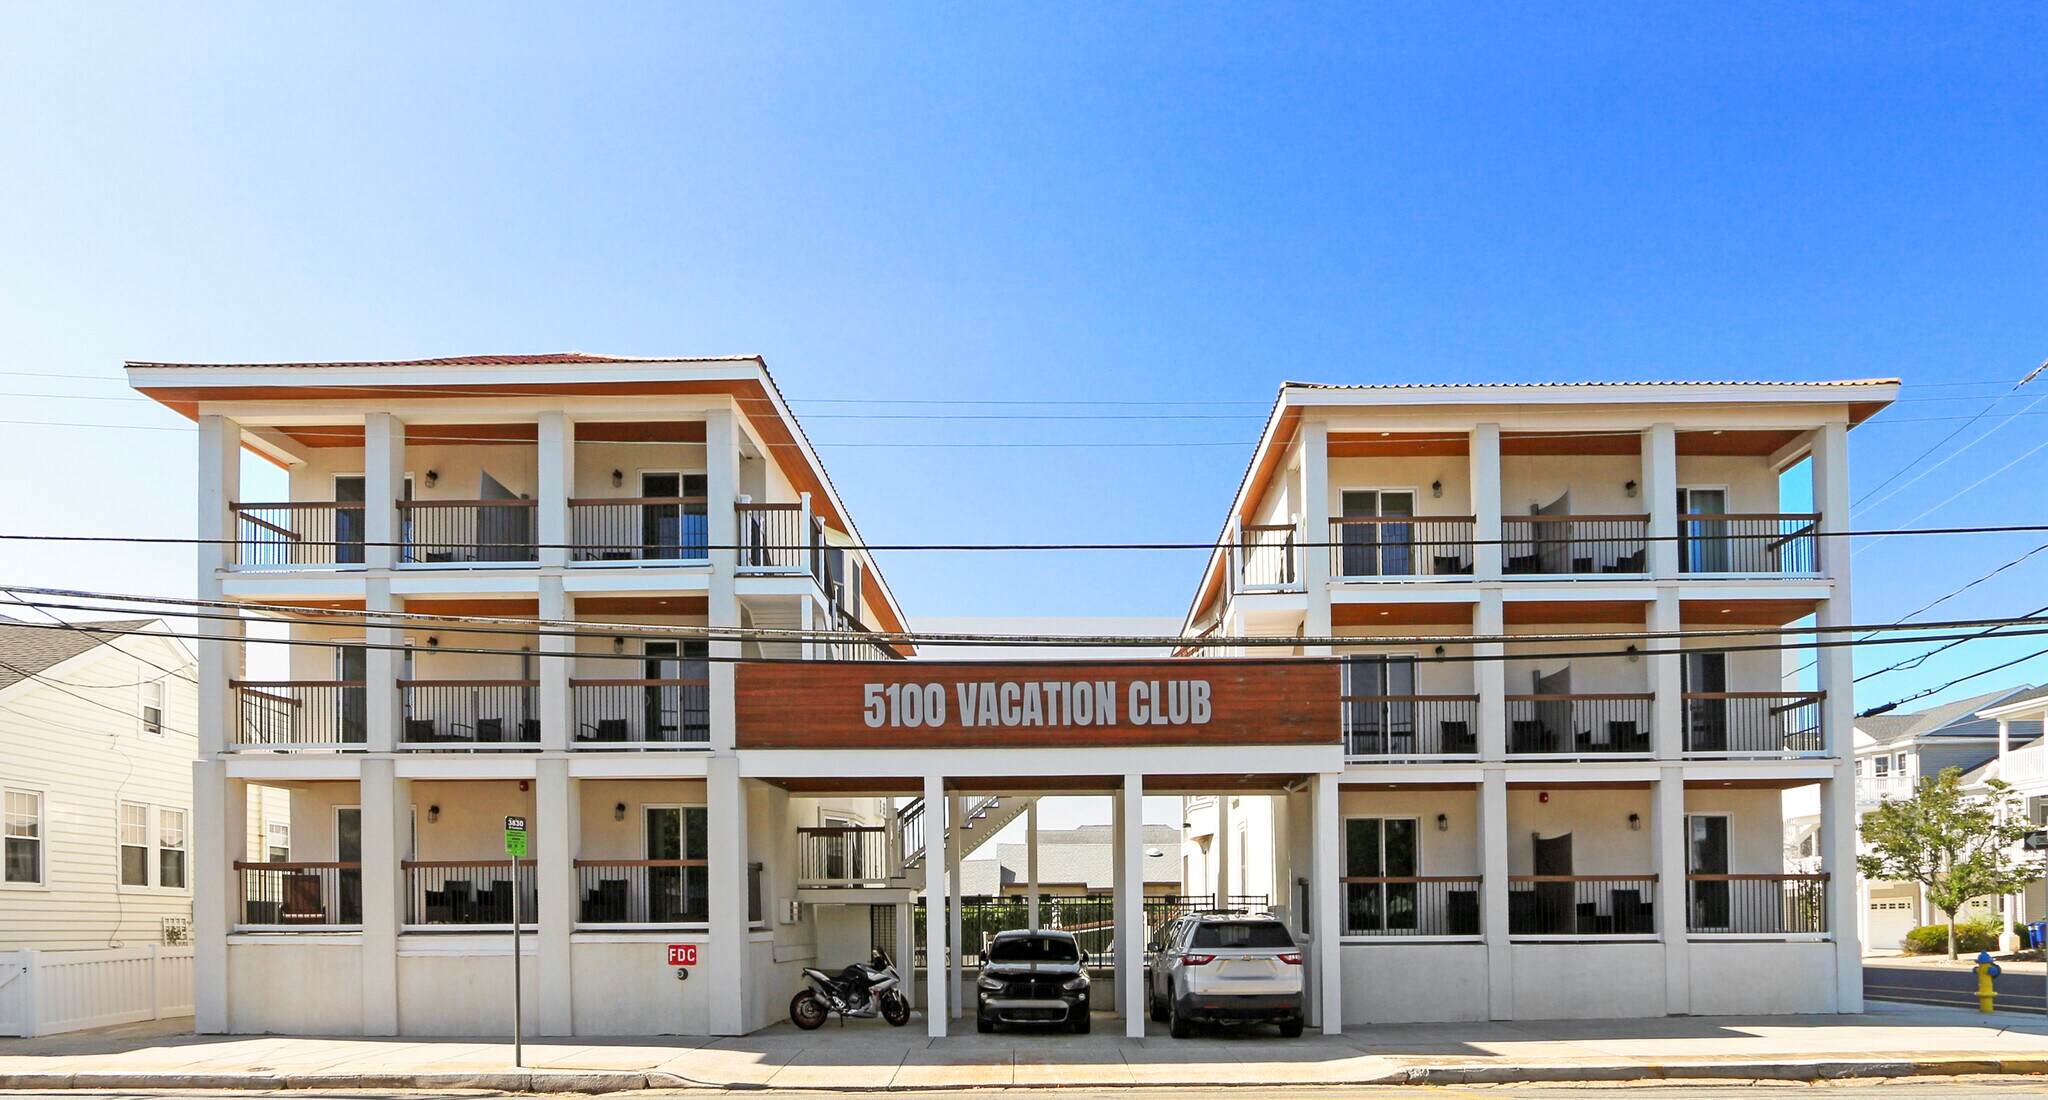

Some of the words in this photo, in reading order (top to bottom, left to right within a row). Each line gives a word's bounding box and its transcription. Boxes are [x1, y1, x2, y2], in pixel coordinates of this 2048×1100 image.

[864, 683, 946, 727] 5100
[956, 681, 1117, 726] VACATION
[1128, 680, 1212, 725] CLUB
[669, 948, 696, 962] FDC
